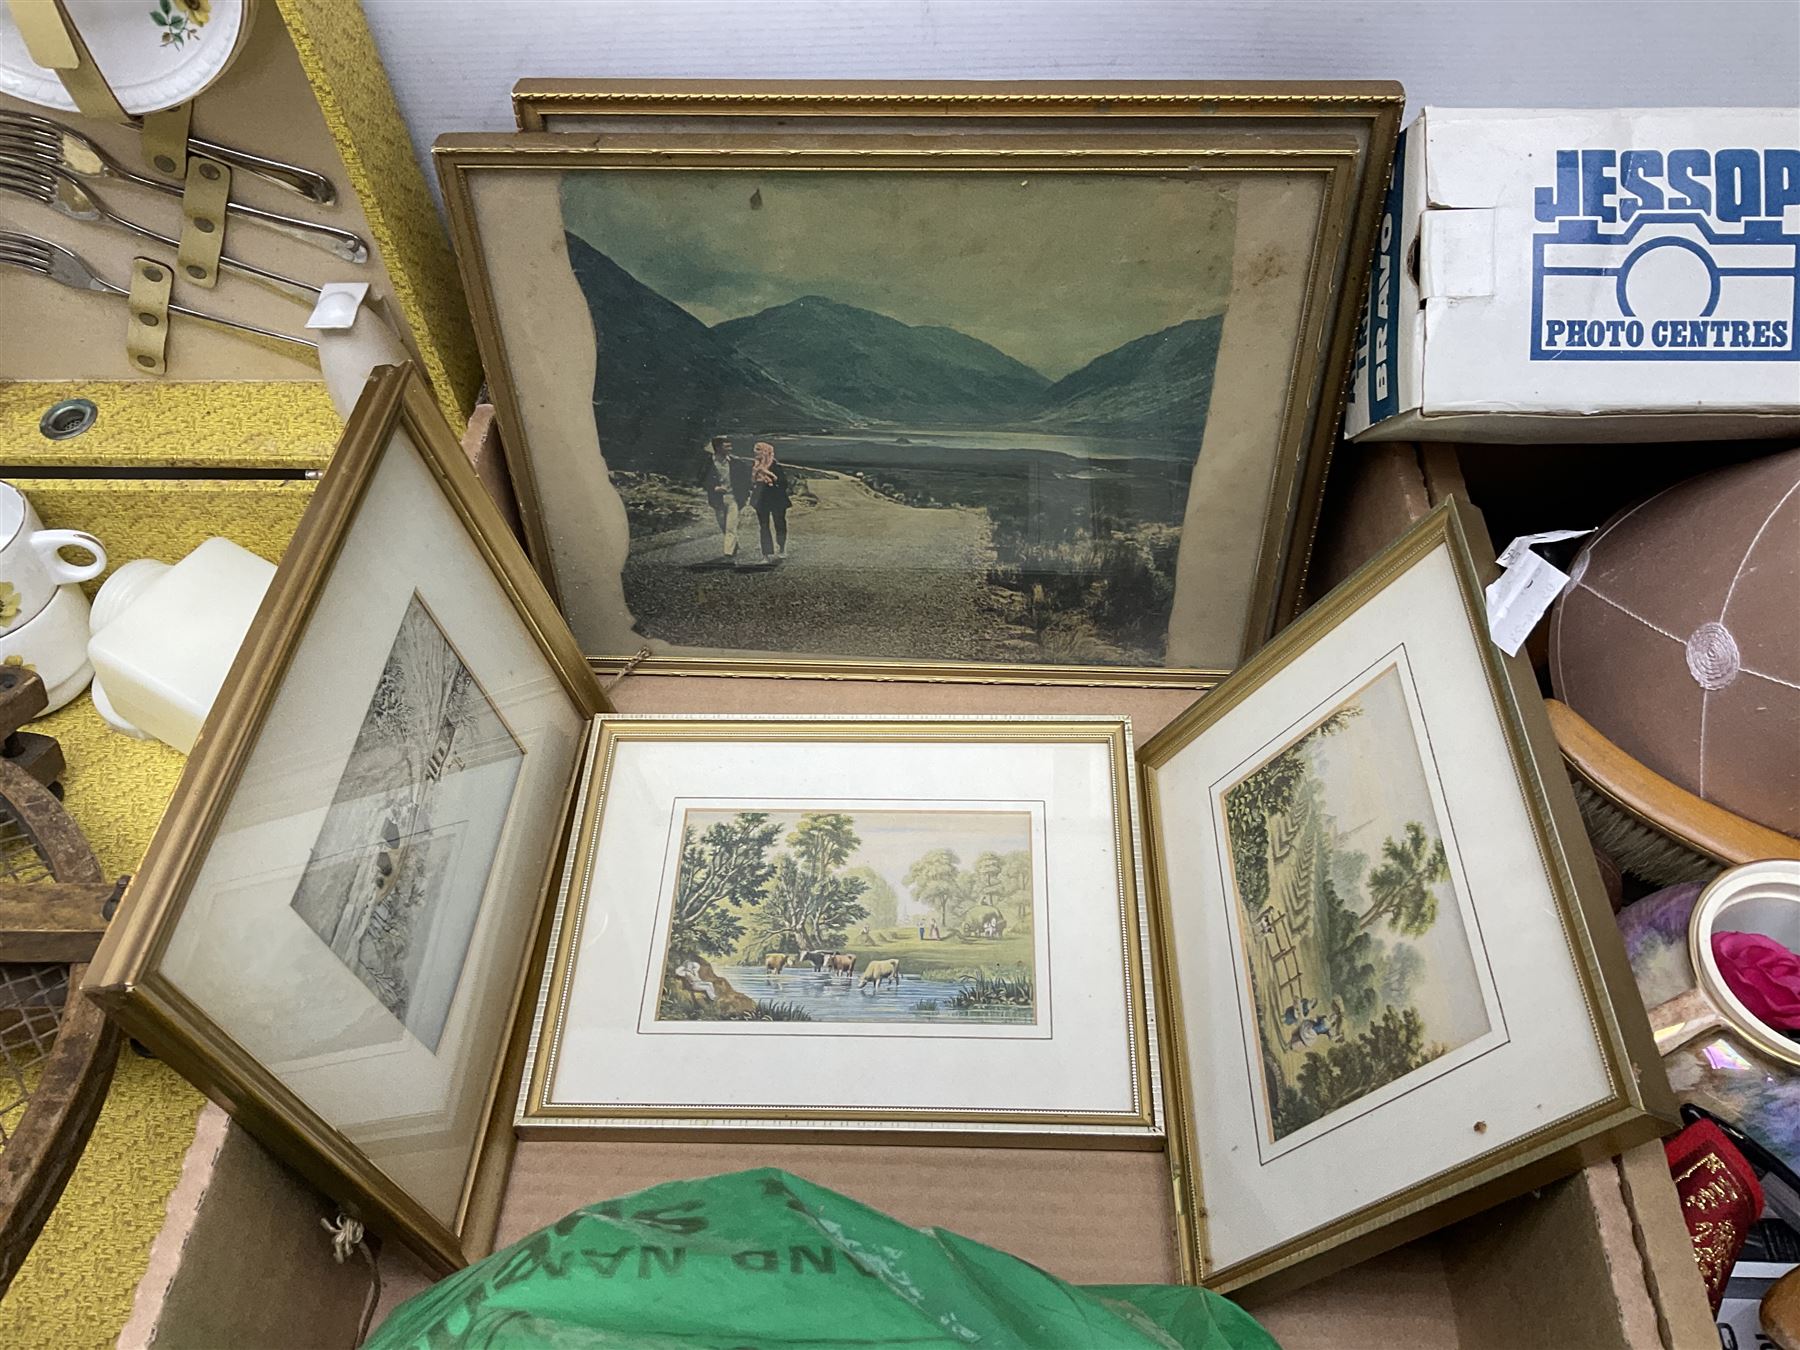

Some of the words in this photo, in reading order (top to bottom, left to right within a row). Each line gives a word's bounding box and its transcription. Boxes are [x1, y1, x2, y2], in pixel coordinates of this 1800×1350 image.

[1534, 149, 1800, 222] JESSOP
[1376, 213, 1392, 402] BRAVO
[1545, 319, 1644, 347] PHOTO
[1651, 320, 1788, 348] CENTRES
